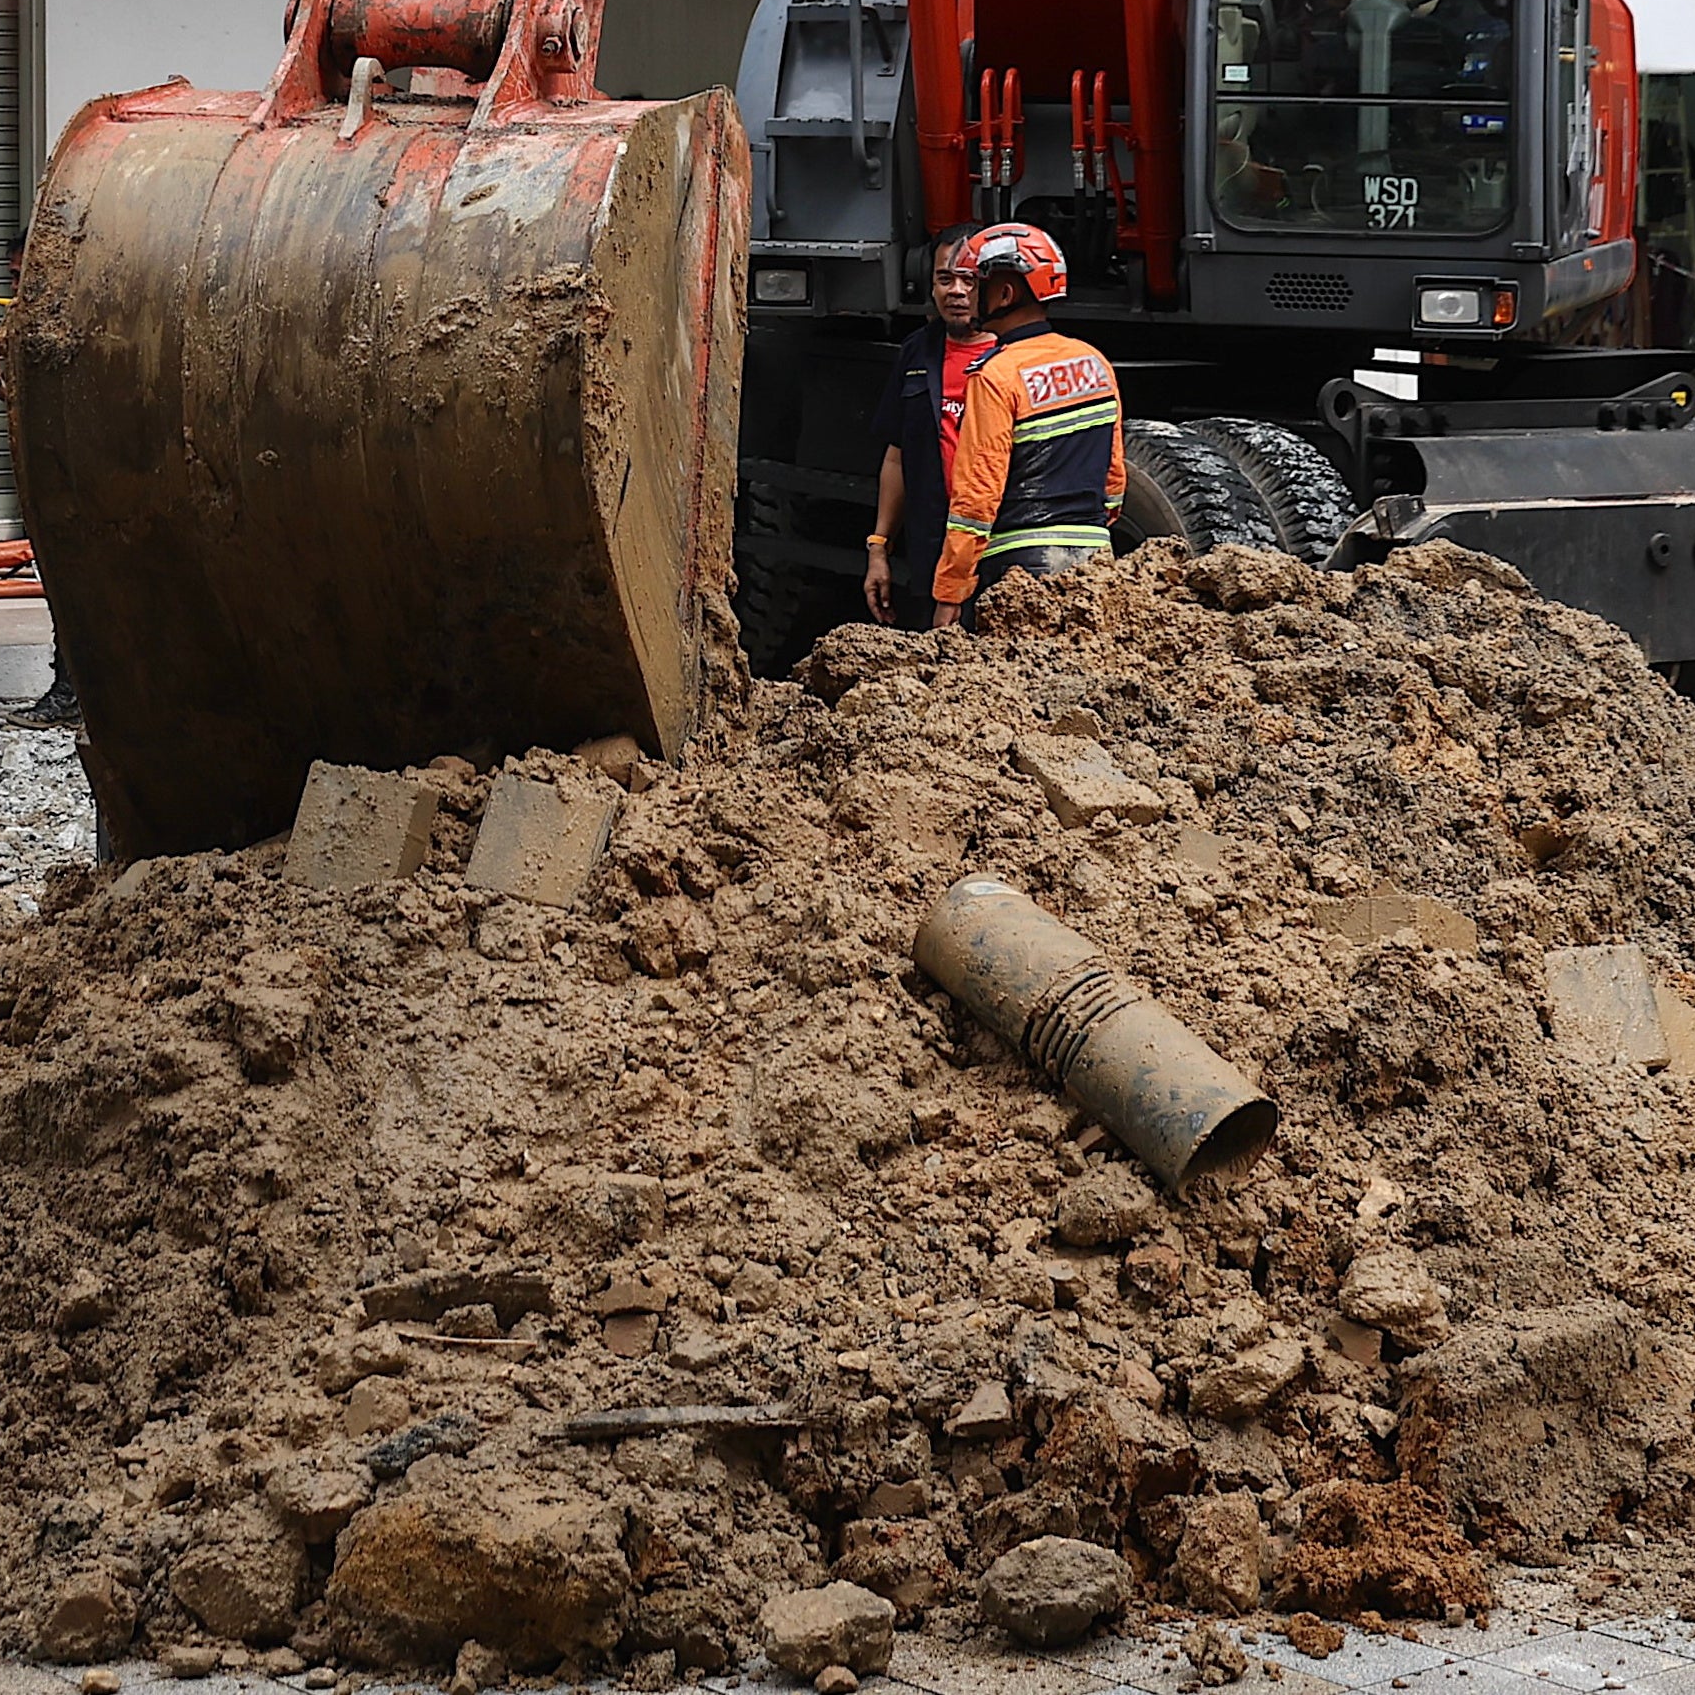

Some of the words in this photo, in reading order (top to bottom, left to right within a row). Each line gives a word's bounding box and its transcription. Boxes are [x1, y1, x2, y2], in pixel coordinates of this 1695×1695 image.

[1364, 176, 1418, 205] WSD
[1367, 204, 1415, 229] 371
[1026, 358, 1110, 403] DBKL
